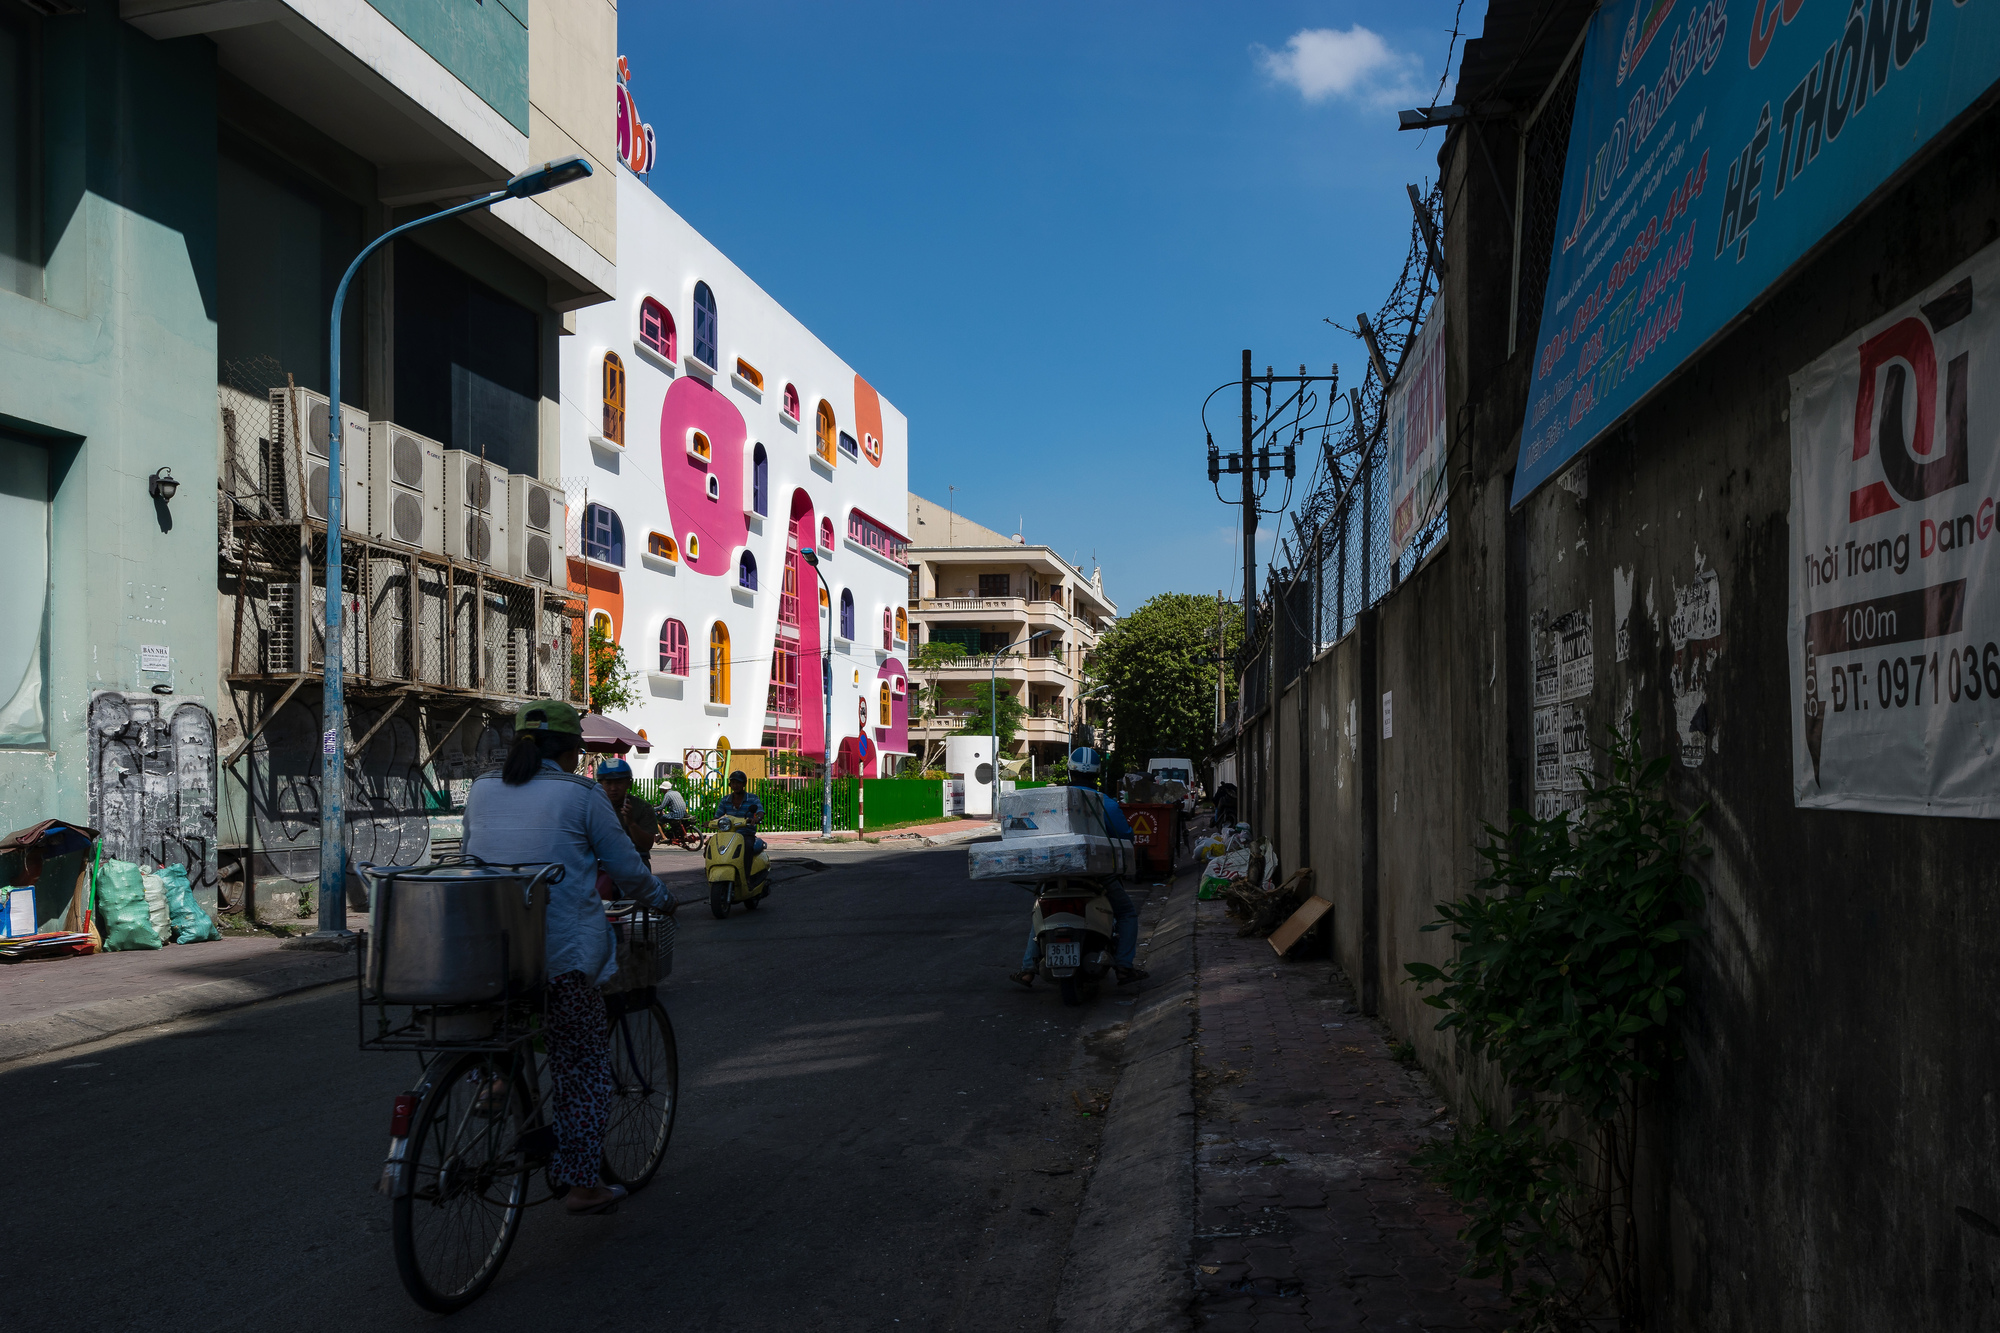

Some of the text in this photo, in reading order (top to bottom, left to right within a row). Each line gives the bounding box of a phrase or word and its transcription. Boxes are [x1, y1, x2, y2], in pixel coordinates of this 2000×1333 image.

[1689, 105, 1708, 143] VN
[1714, 99, 1773, 264] HỆ
[1845, 532, 1910, 576] Trang
[1842, 605, 1897, 644] 100m
[1806, 640, 1819, 718] 50m
[1831, 662, 1869, 712] ĐT:
[1877, 651, 1939, 710] 0971
[1133, 835, 1150, 844] 154
[1049, 955, 1078, 966] 128.16
